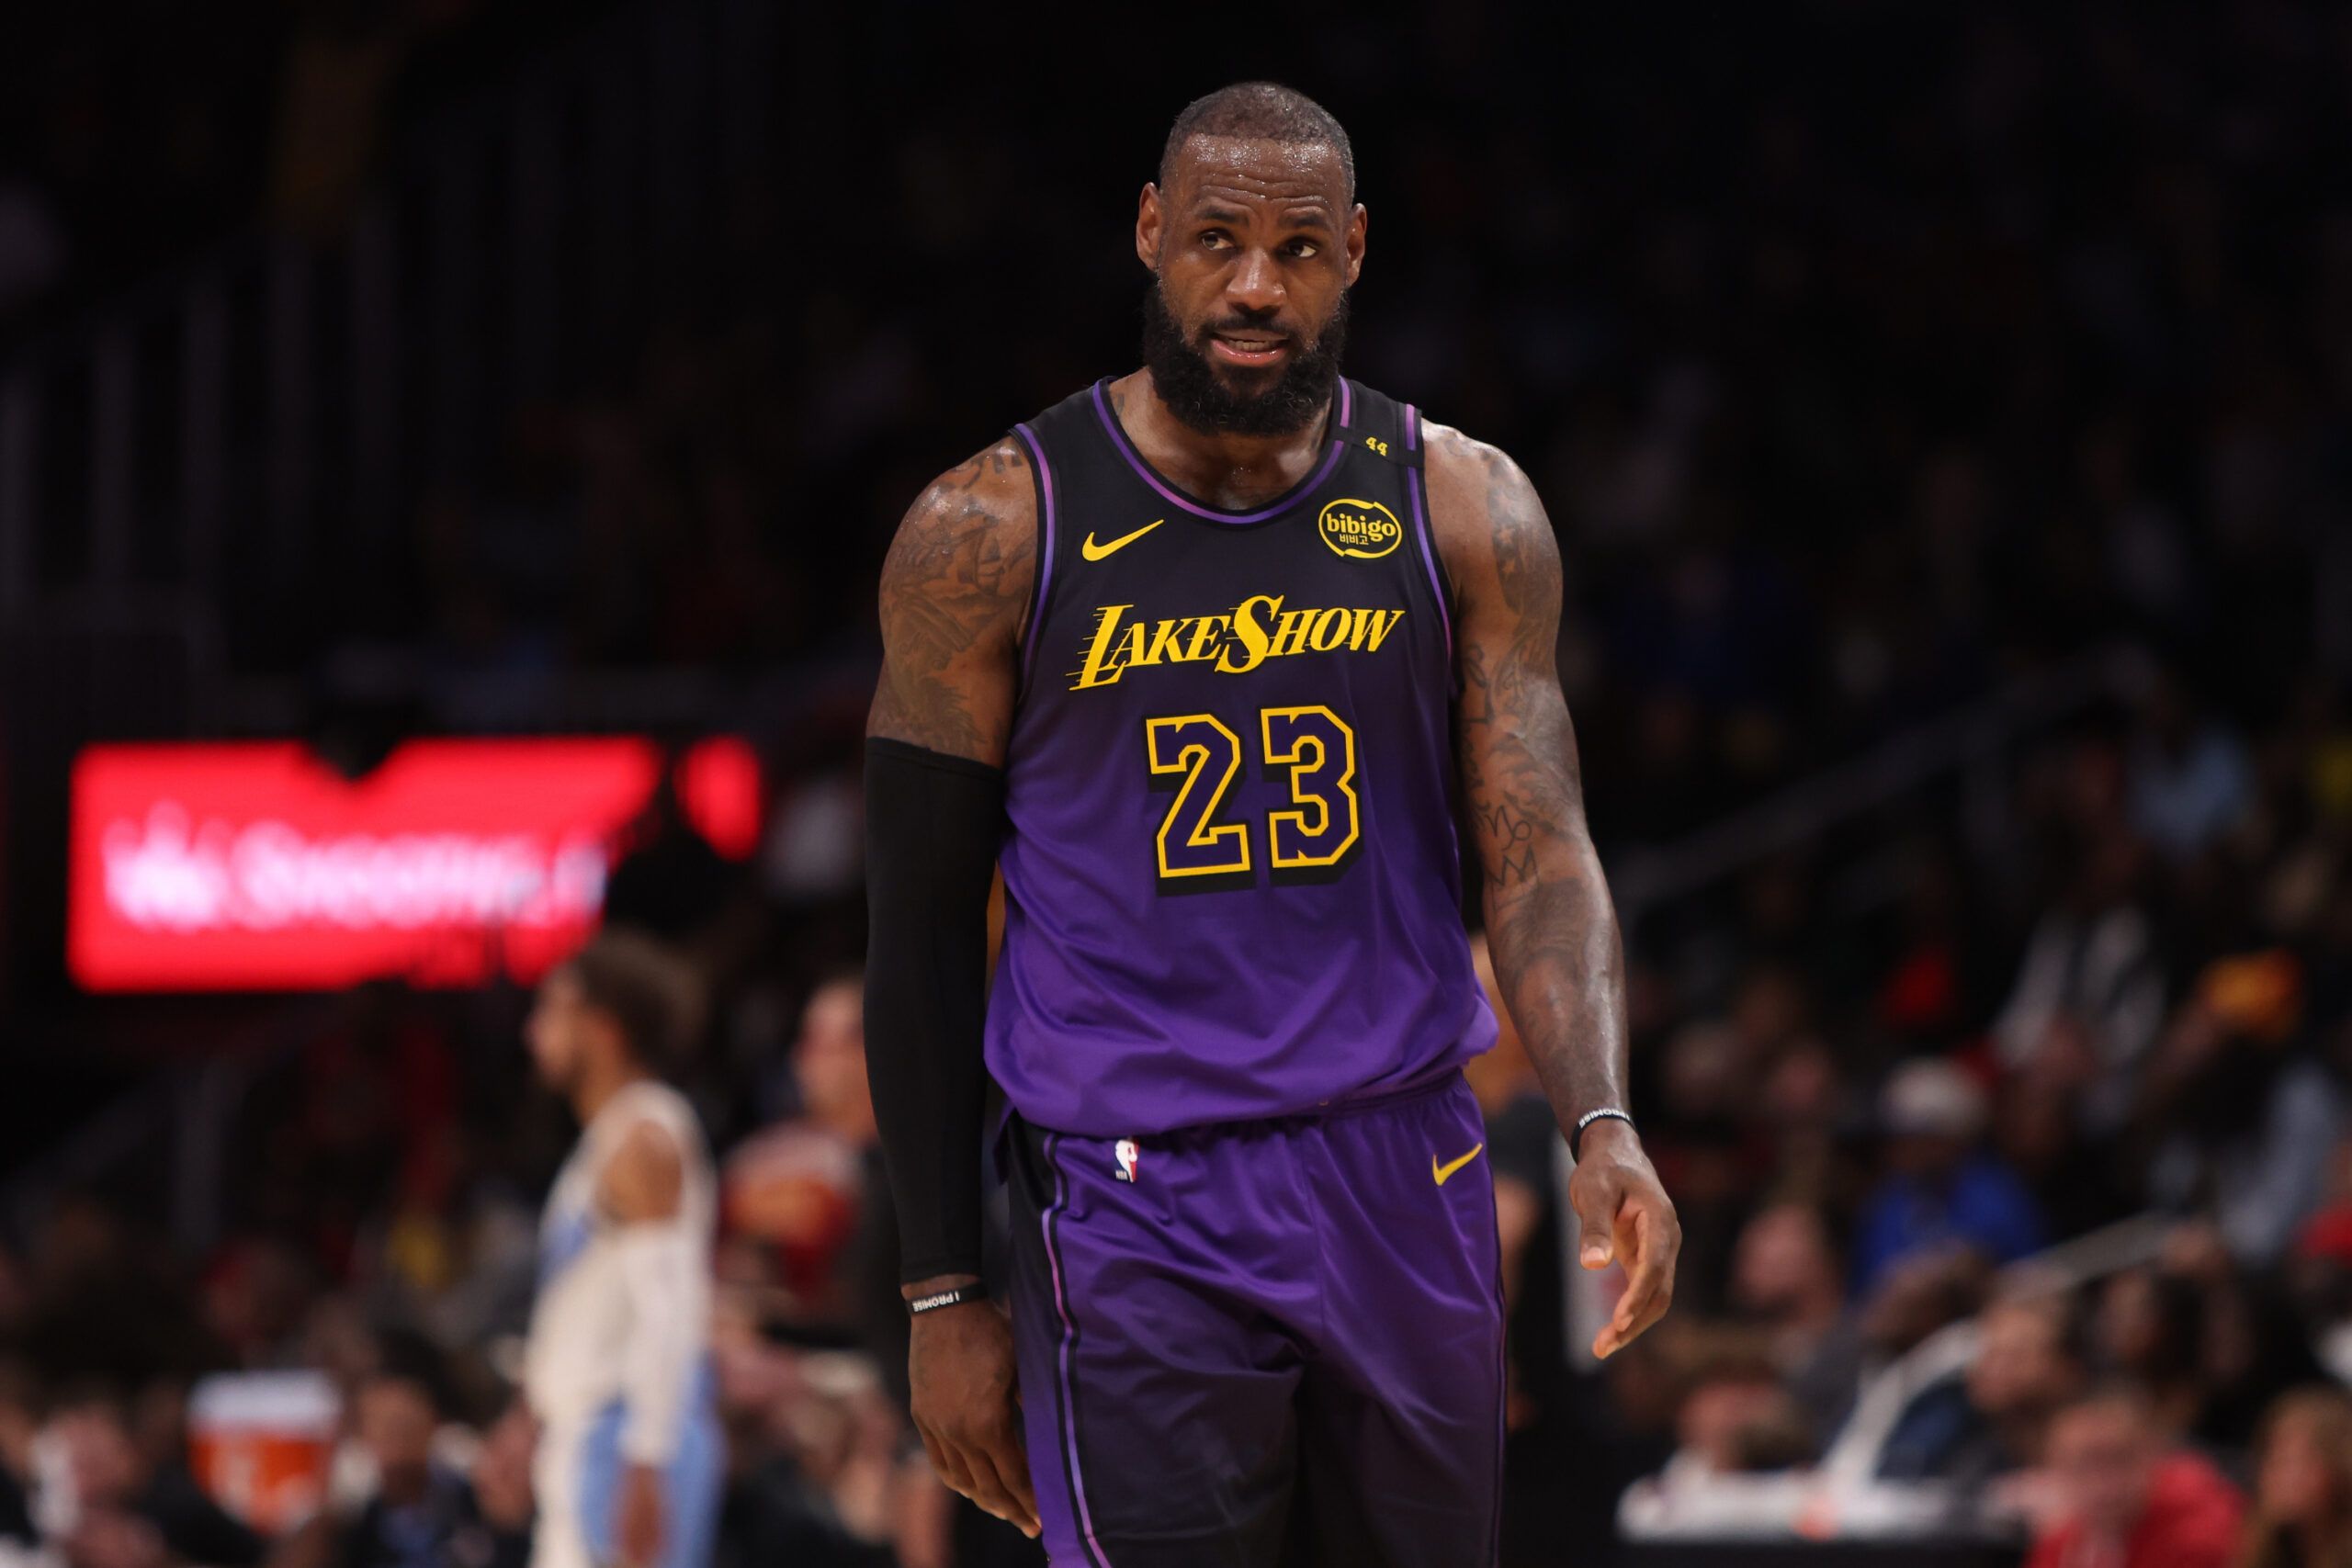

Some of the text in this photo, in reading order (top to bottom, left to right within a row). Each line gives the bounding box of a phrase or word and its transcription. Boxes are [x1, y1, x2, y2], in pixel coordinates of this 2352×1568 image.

[1365, 436, 1388, 457] 44
[1326, 513, 1396, 542] bibigo
[1339, 533, 1369, 546] 비비고
[1146, 705, 1360, 878] 23
[912, 1292, 955, 1313] PROMISE
